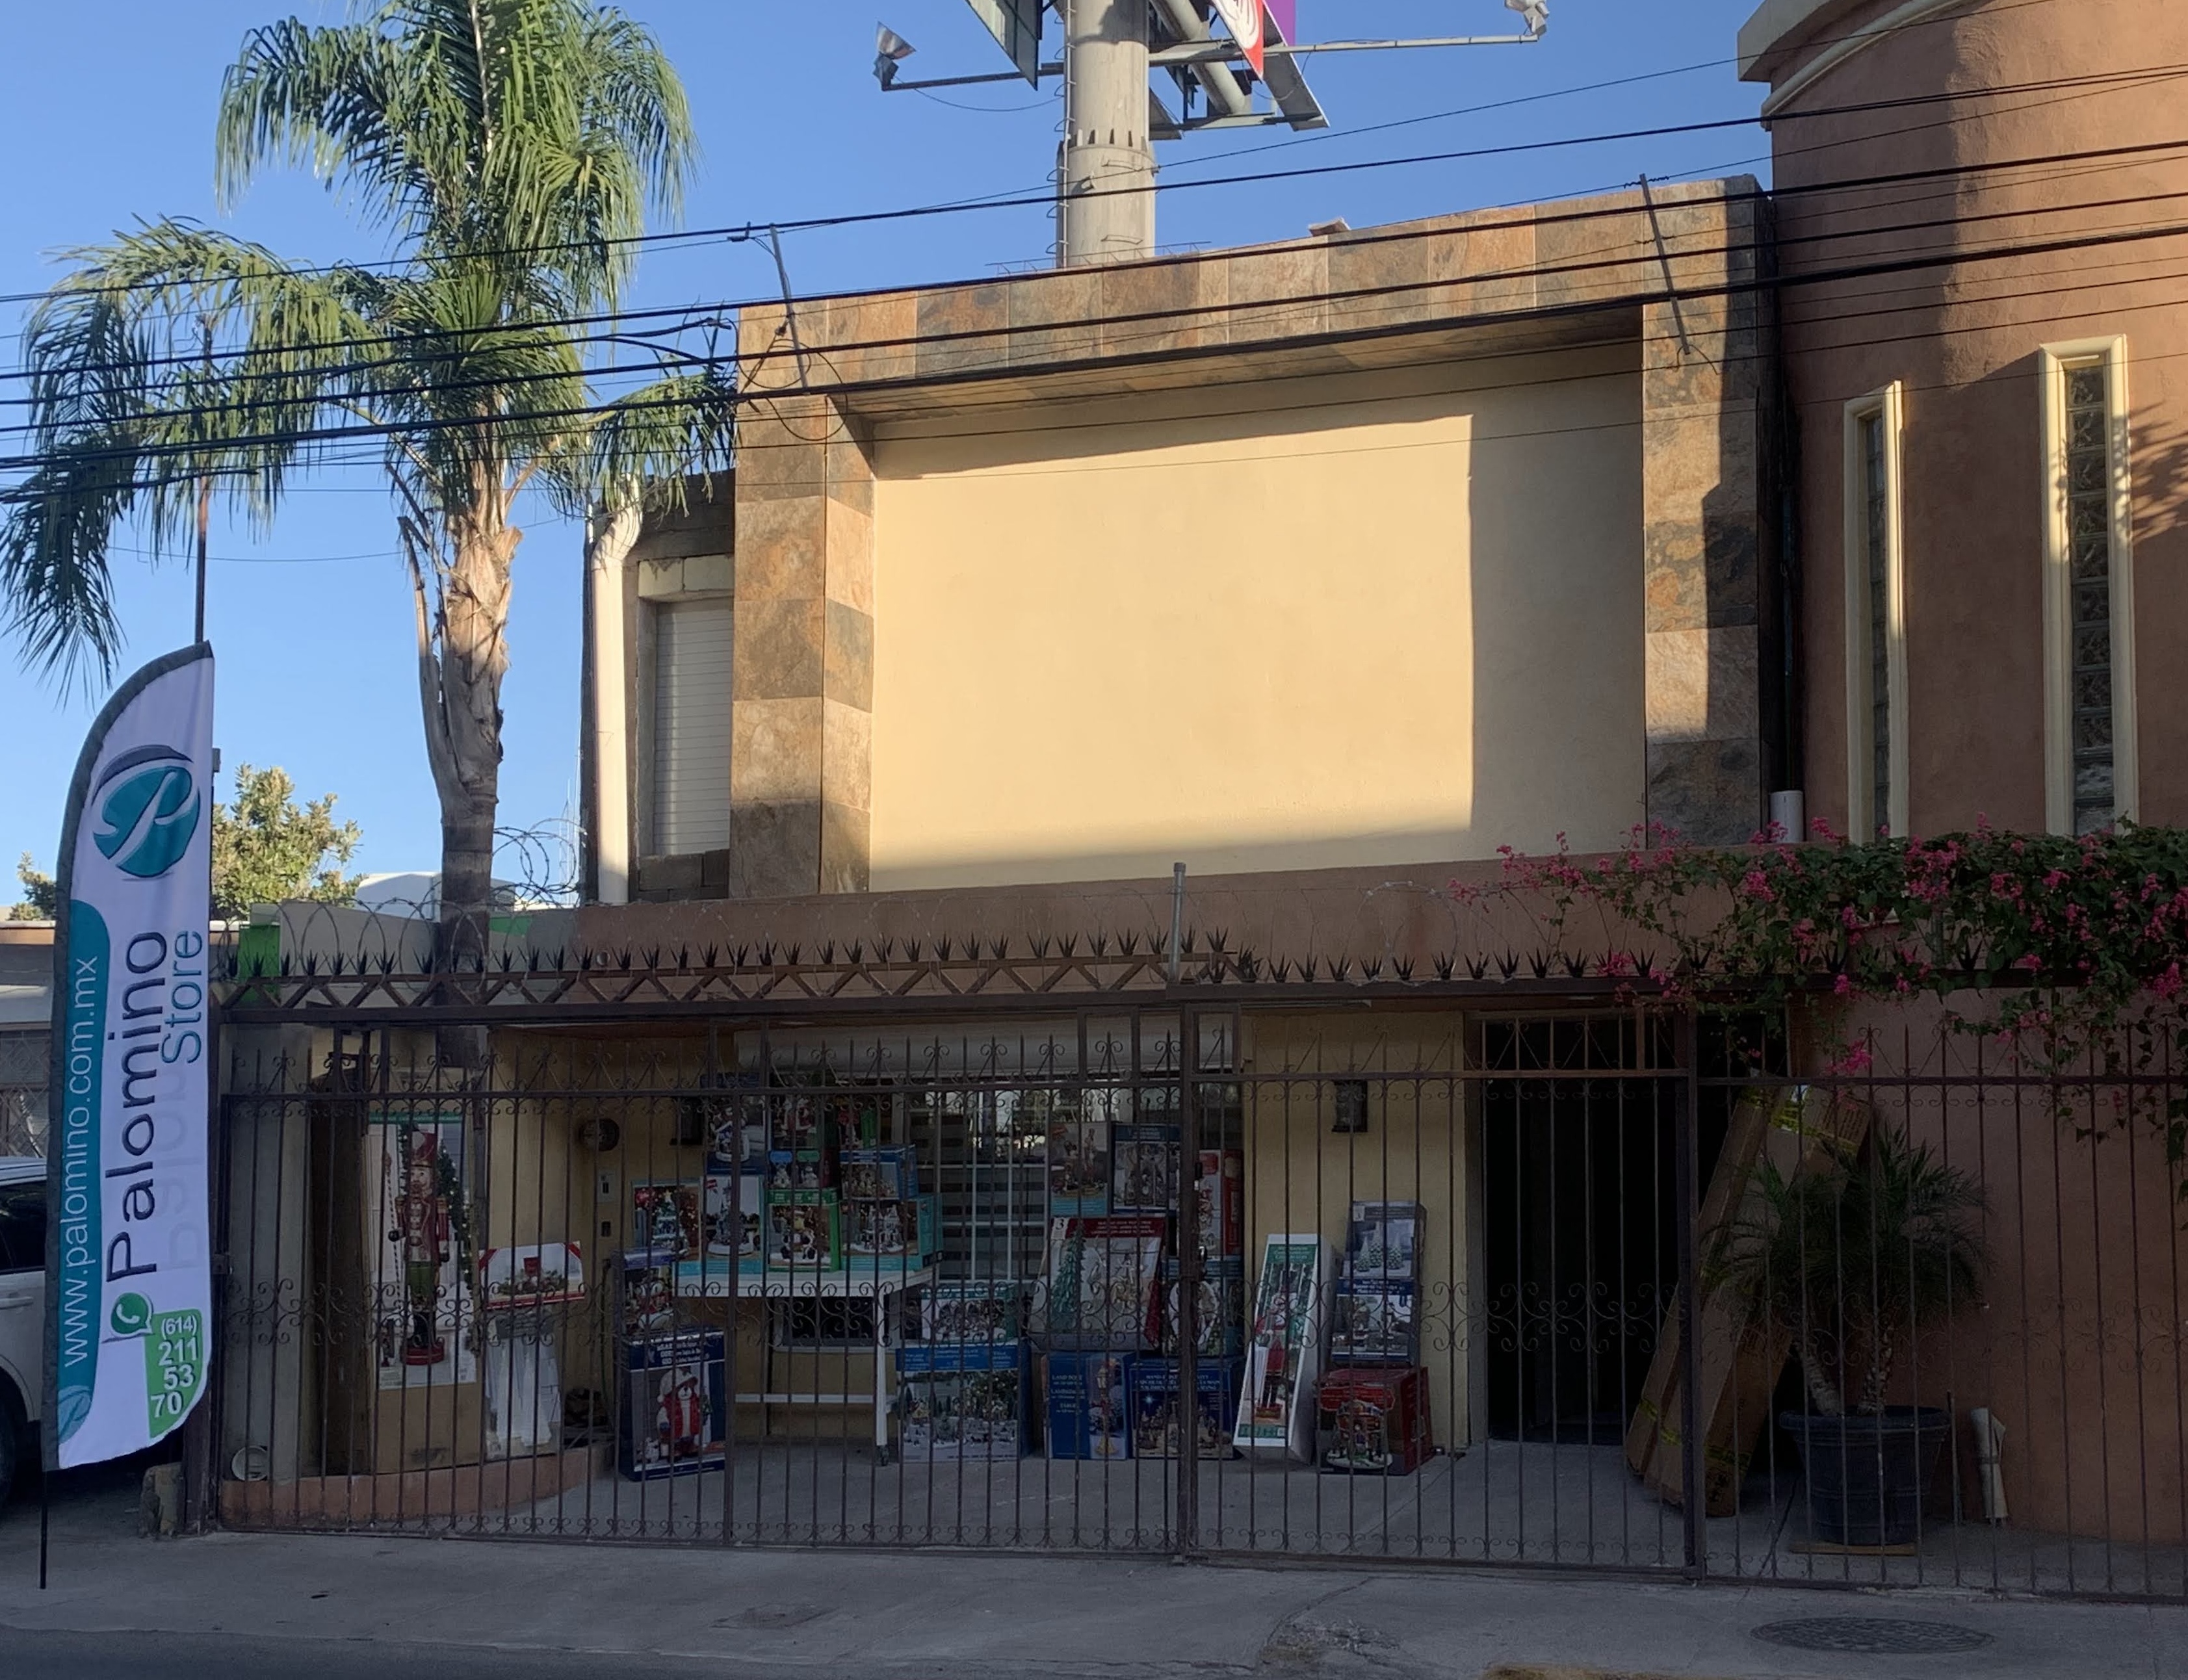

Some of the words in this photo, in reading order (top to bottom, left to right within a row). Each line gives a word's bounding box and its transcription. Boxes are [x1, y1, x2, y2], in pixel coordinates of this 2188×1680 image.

[161, 930, 203, 1064] Store
[105, 931, 167, 1282] Palomino
[60, 956, 98, 1367] www.palomino.com.mx
[162, 1314, 198, 1339] (614)
[158, 1336, 198, 1366] 211
[164, 1363, 195, 1390] 53
[150, 1391, 183, 1418] 70
